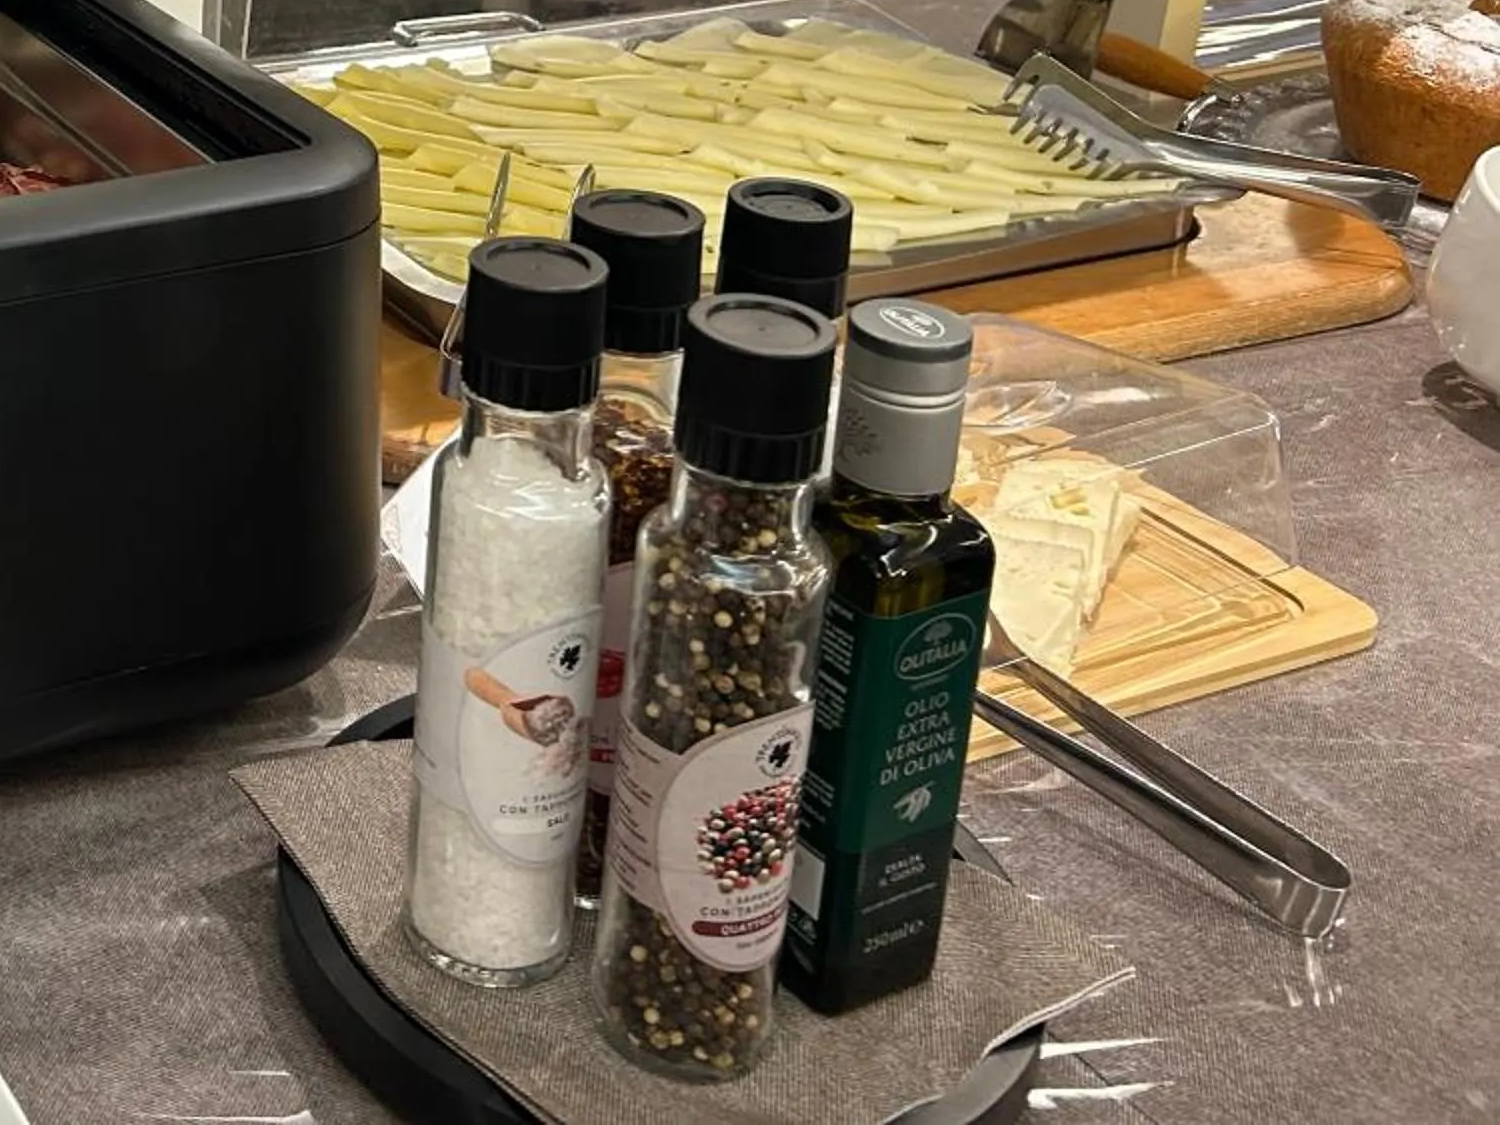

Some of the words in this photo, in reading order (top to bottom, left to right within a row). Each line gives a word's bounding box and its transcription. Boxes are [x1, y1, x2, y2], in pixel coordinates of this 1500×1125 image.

[900, 639, 968, 672] OLITALIA
[904, 692, 949, 718] OLIO
[897, 711, 950, 740] EXTRA
[885, 727, 958, 763] VERGINE
[880, 769, 899, 786] DI
[904, 747, 955, 776] OLIVA
[700, 906, 730, 916] CON
